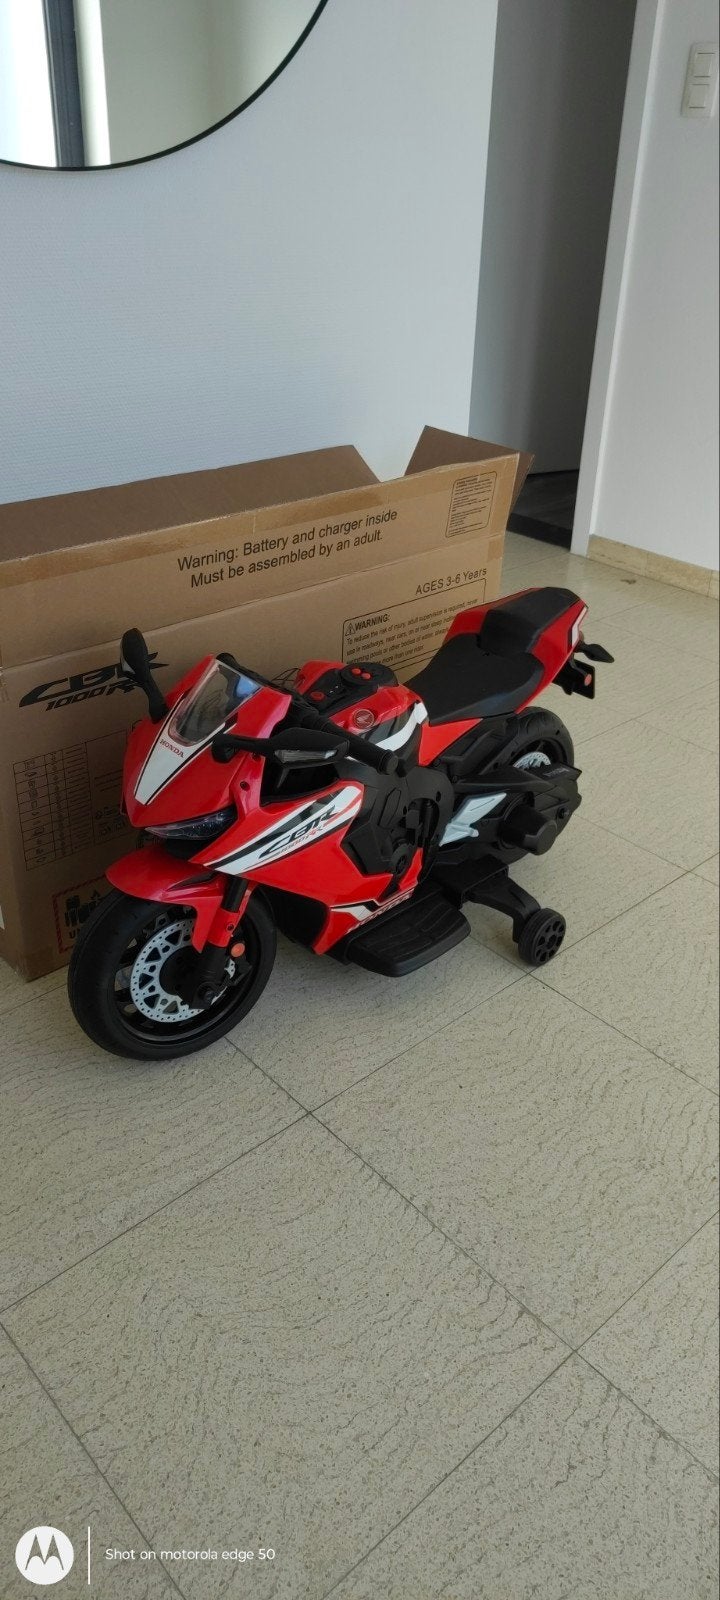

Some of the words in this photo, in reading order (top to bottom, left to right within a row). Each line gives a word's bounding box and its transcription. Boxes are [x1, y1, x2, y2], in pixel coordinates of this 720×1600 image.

[178, 548, 238, 572] Warning:
[243, 536, 288, 556] Battery
[292, 527, 315, 544] and
[318, 518, 363, 538] charger
[366, 510, 398, 526] inside
[191, 568, 224, 588] Must
[228, 566, 244, 578] be
[248, 545, 315, 574] assembled
[320, 543, 333, 558] by
[336, 540, 350, 552] an
[354, 530, 383, 546] adult.
[415, 579, 444, 596] AGES
[446, 574, 460, 587] 3-6
[463, 568, 487, 580] Years
[355, 614, 390, 631] WARNING:
[160, 739, 184, 758] HONDA
[258, 804, 338, 860] CBR
